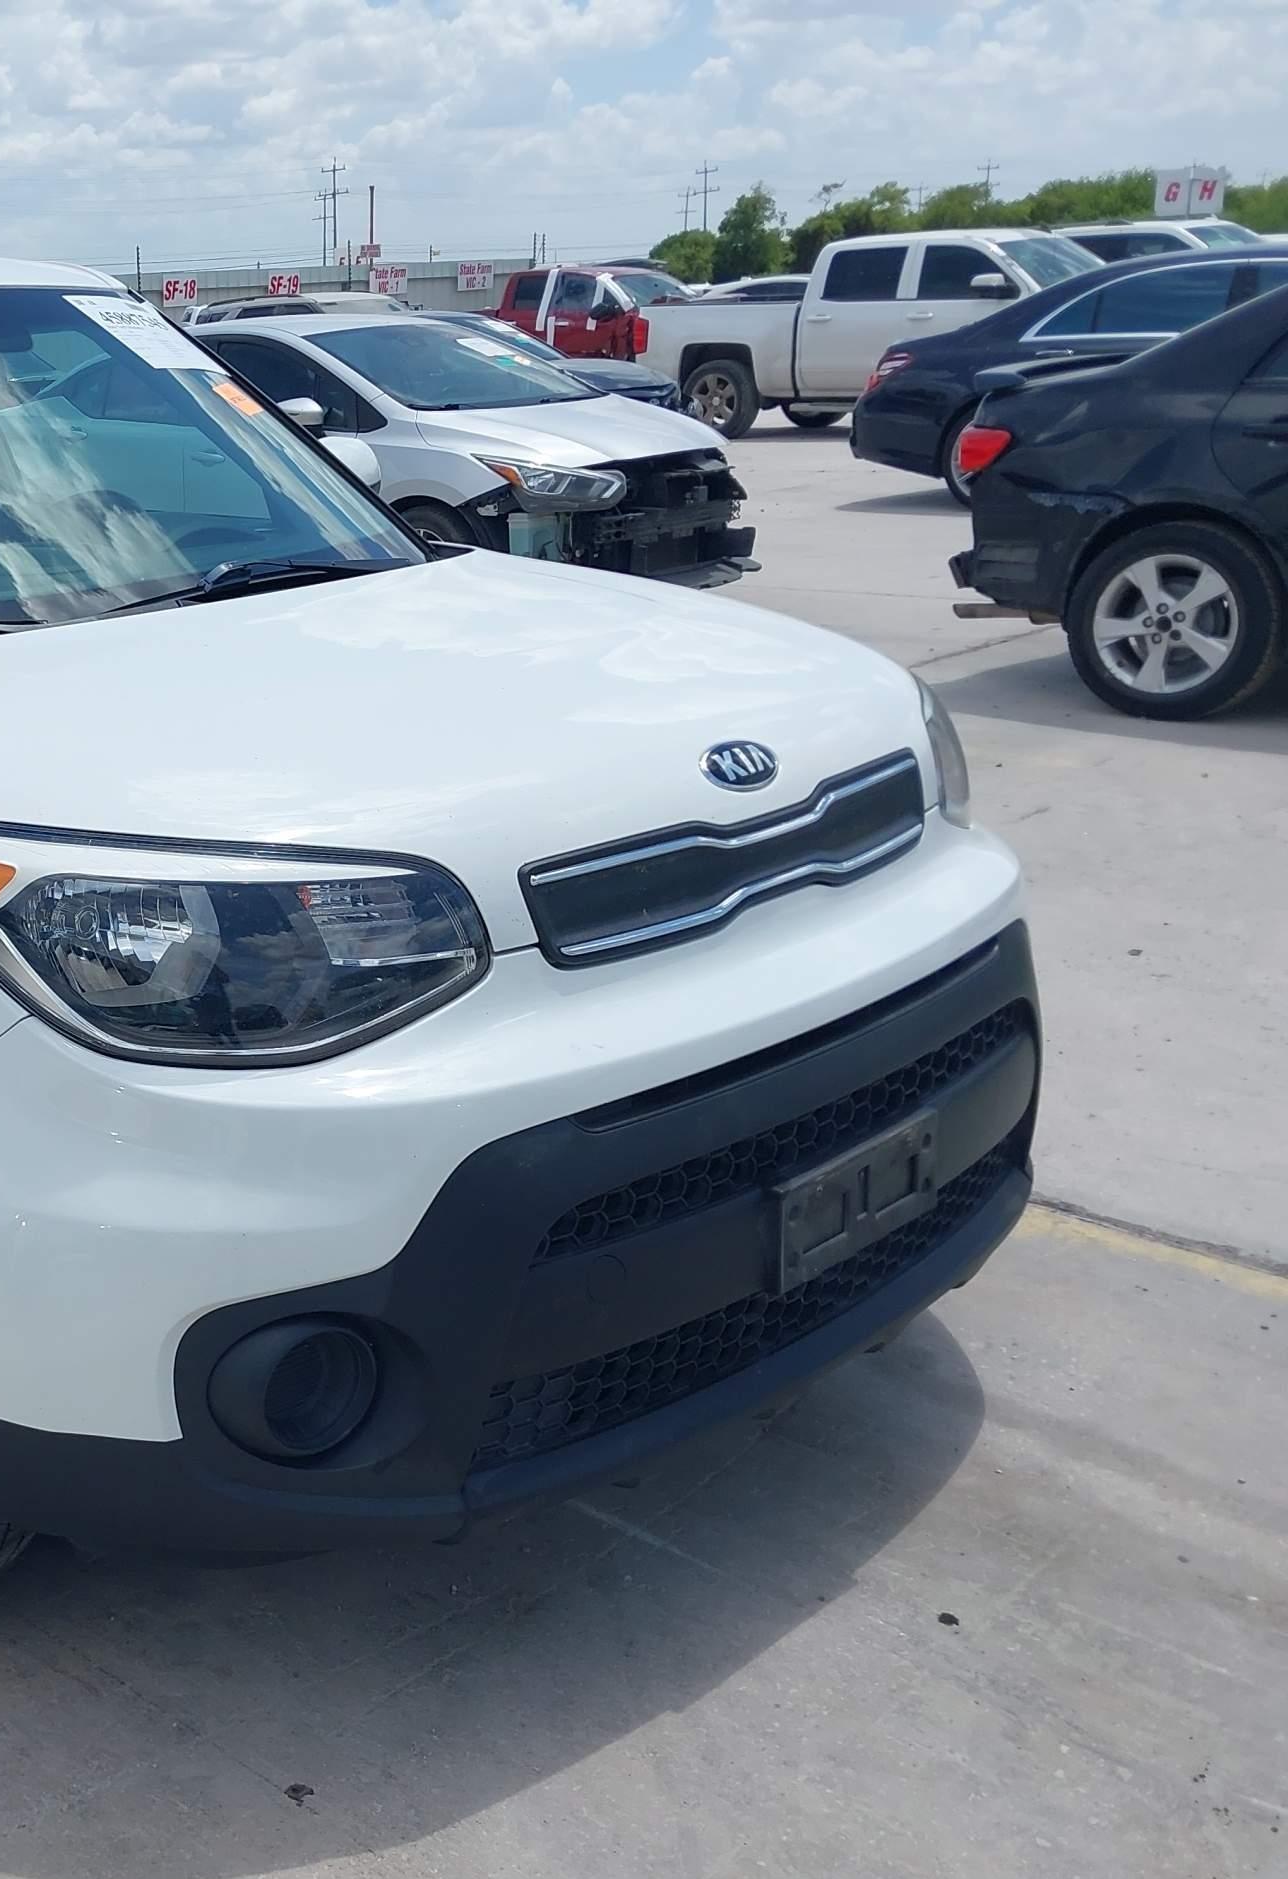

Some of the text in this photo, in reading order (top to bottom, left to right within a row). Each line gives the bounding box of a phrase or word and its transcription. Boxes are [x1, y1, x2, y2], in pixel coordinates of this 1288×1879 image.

[1164, 181, 1181, 202] G
[1198, 180, 1217, 201] H
[372, 266, 407, 279] tate Farm
[459, 263, 492, 275] State Farm
[164, 280, 196, 300] SF-18
[270, 275, 299, 294] SF-19
[466, 276, 476, 288] VIC
[711, 744, 775, 781] KIA
